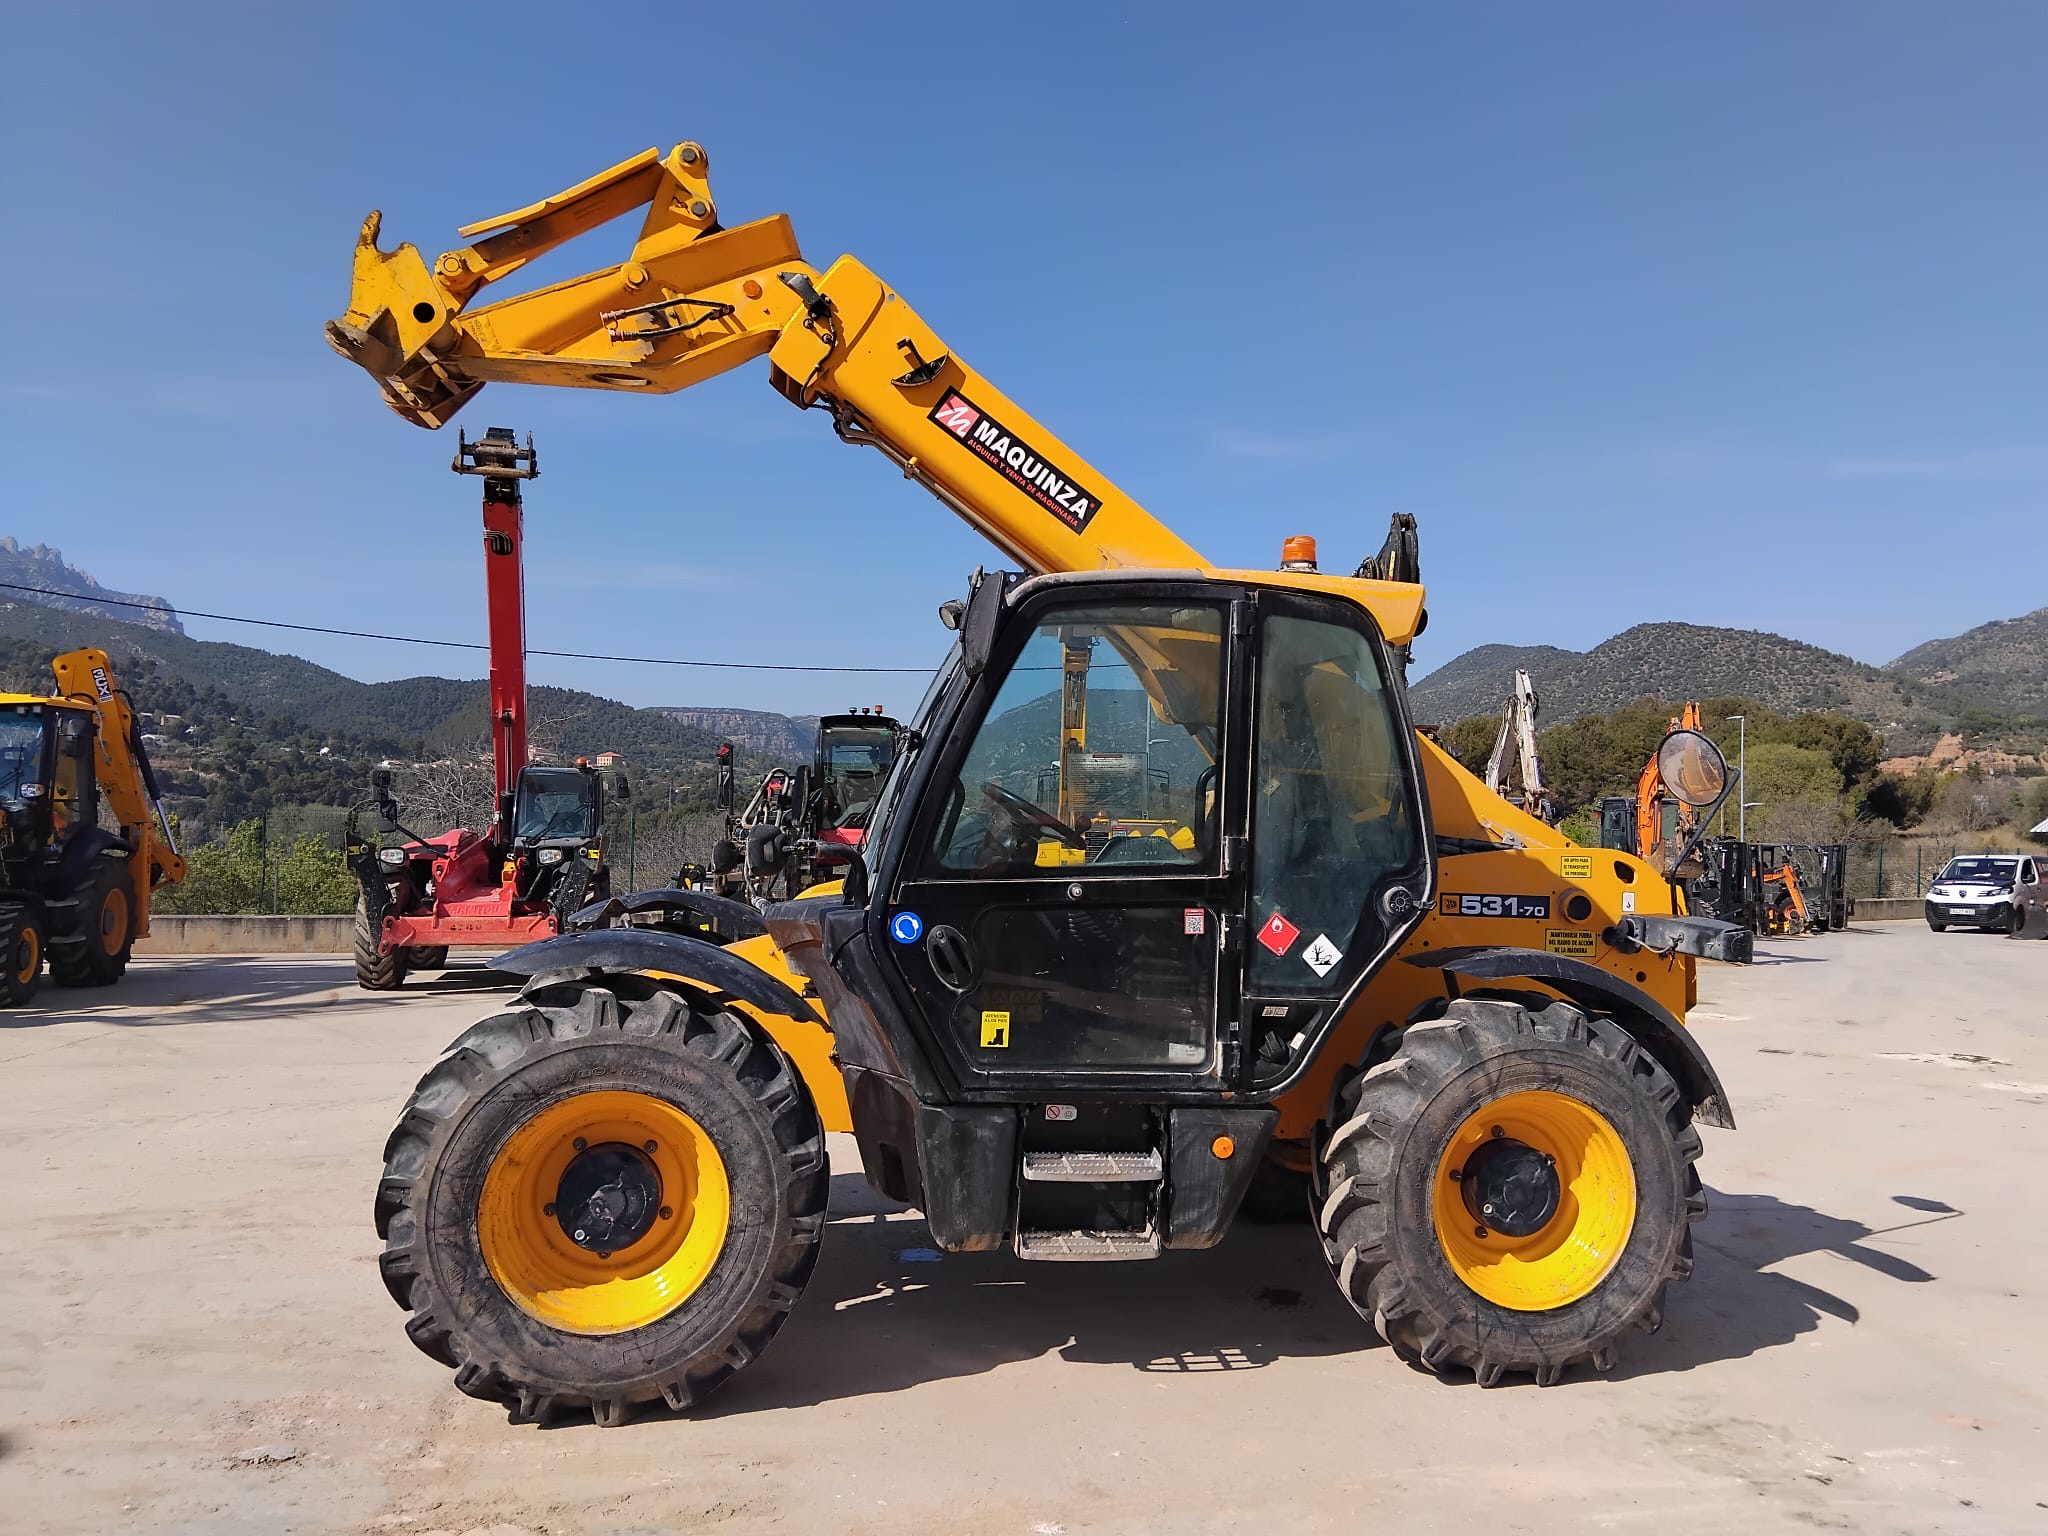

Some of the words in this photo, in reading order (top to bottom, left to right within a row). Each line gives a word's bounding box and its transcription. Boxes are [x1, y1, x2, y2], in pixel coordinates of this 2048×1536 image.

[967, 439, 999, 465] ALQUILER
[1005, 467, 1026, 487] VENTA
[1026, 484, 1037, 494] DE
[1035, 491, 1079, 527] MAQUINARIA
[973, 419, 1089, 520] MAQUINZA
[92, 668, 111, 696] 3CX
